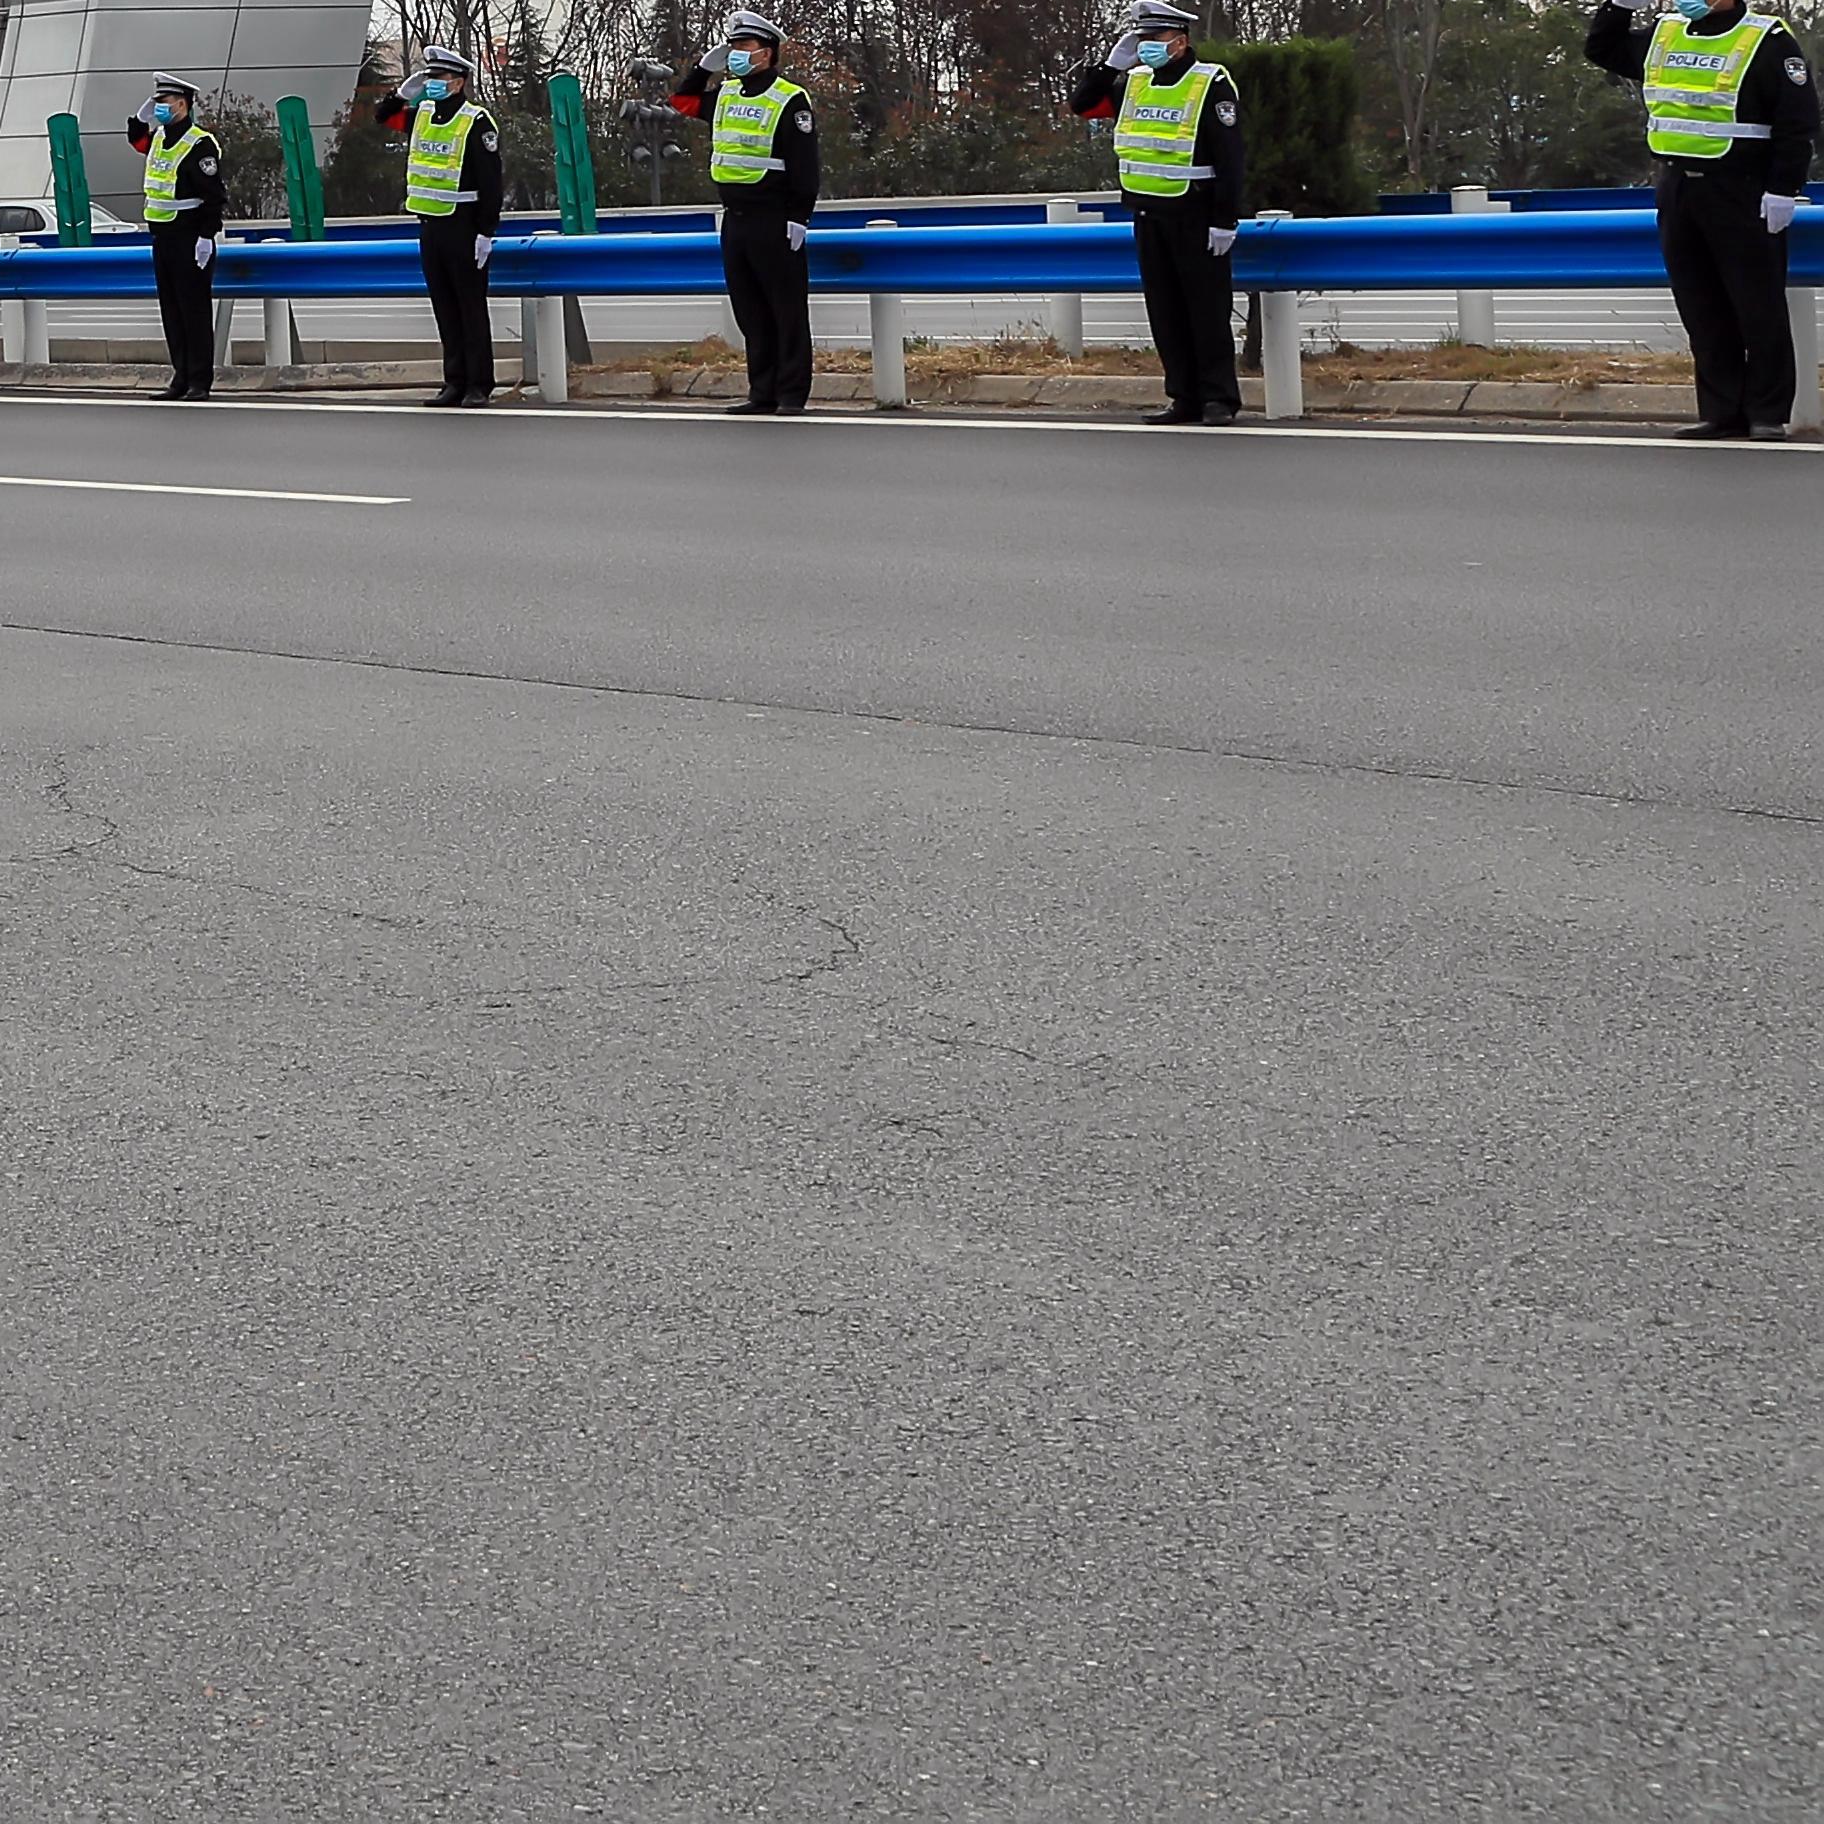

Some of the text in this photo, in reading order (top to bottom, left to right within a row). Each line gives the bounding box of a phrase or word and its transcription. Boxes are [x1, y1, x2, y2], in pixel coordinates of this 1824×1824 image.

[1666, 54, 1722, 68] POLICE
[727, 105, 763, 118] POLICE
[1135, 108, 1179, 121] POLICE
